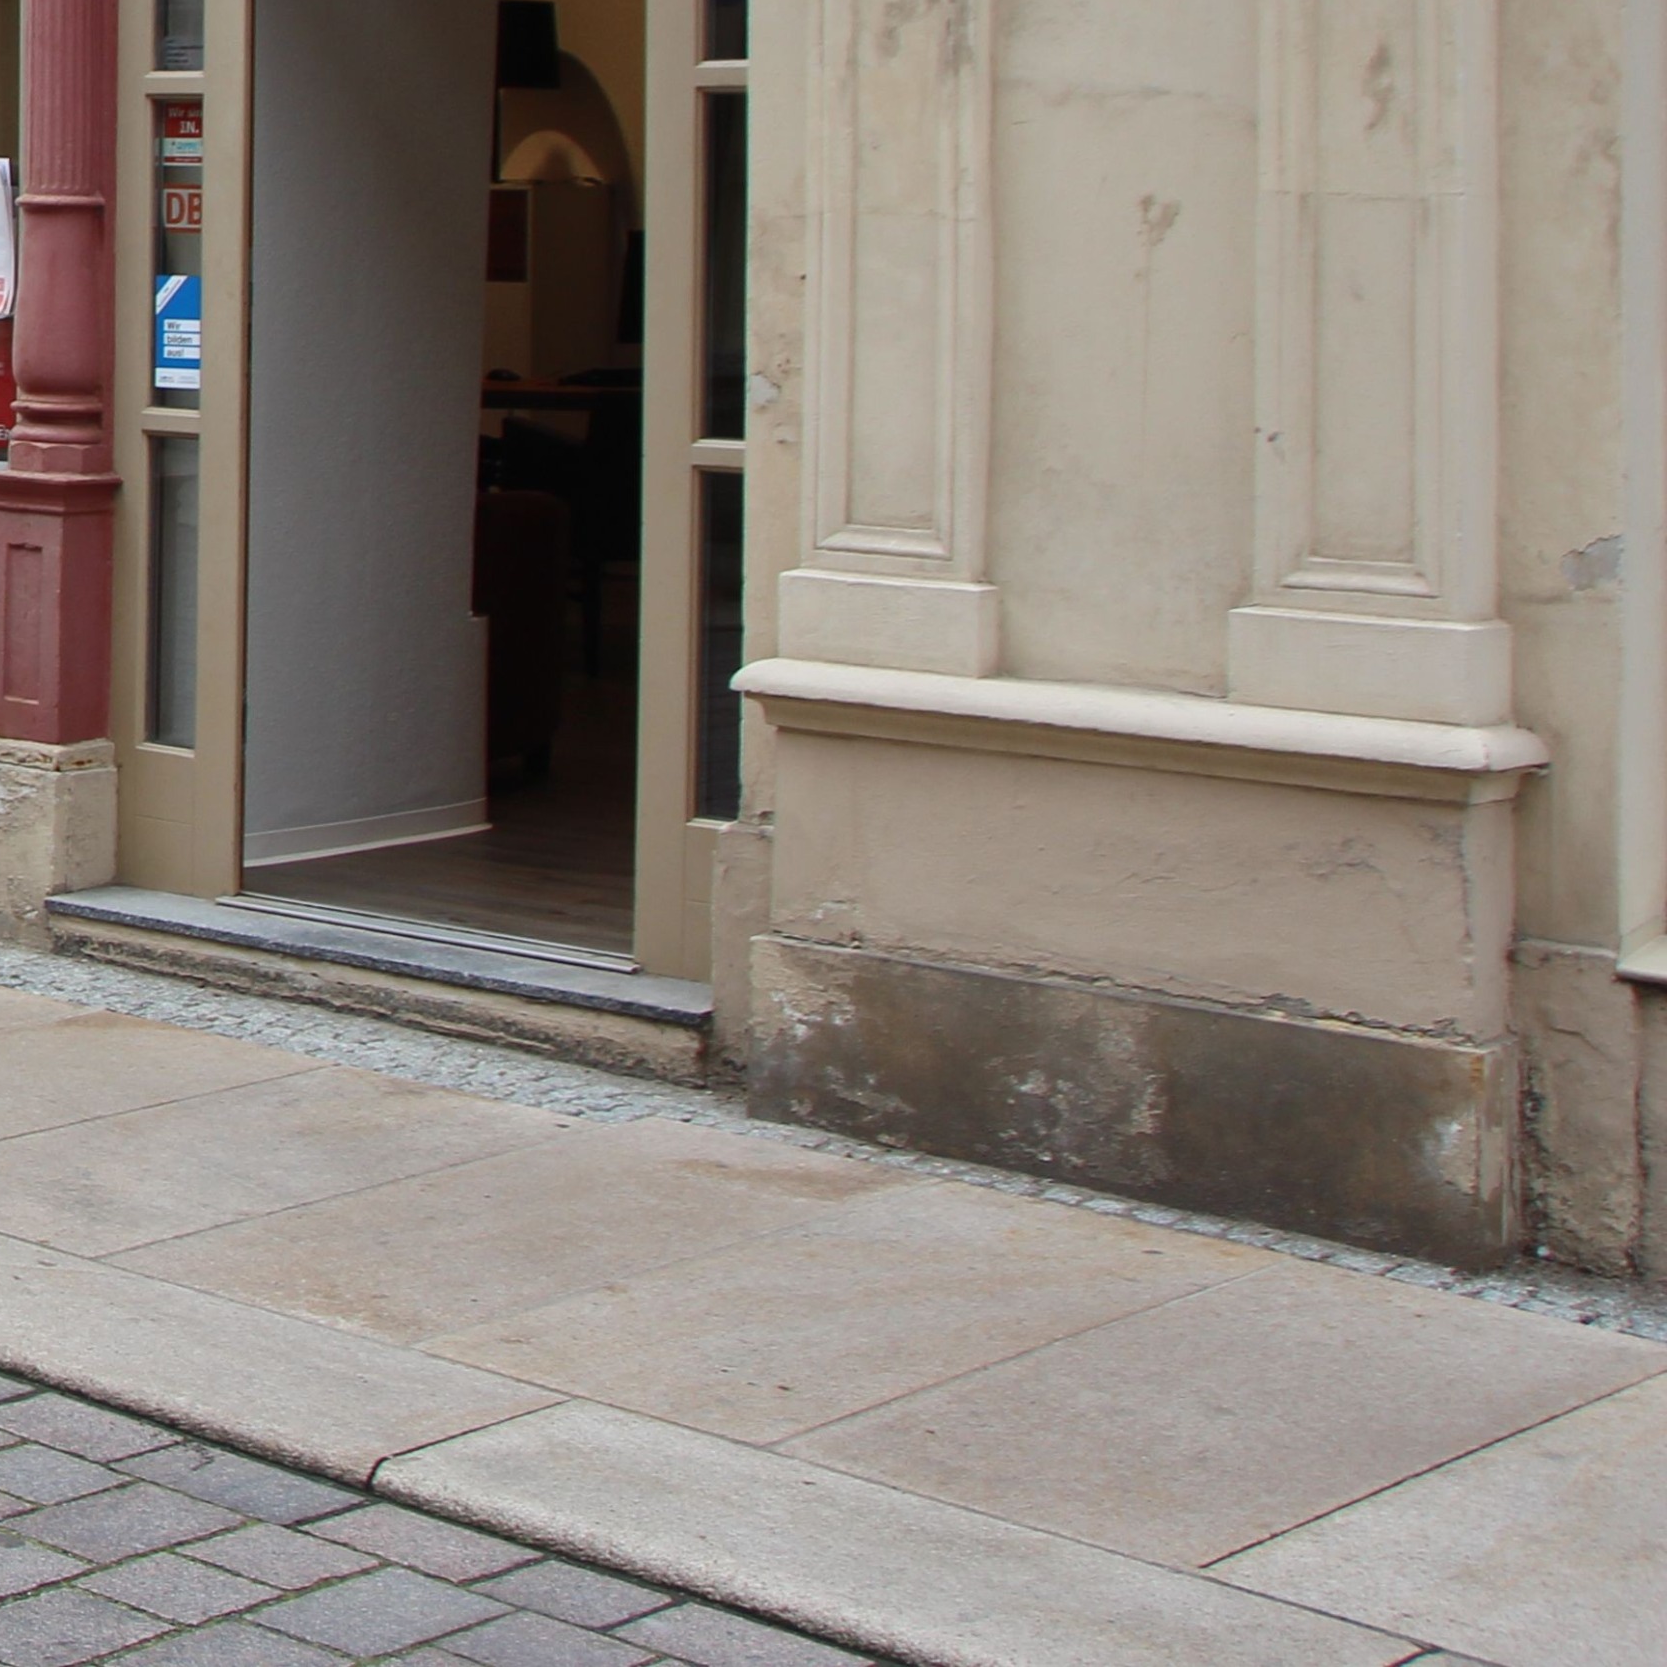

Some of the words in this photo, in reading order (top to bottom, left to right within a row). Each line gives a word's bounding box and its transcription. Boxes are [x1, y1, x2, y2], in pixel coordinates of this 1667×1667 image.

[166, 192, 202, 225] DB
[167, 321, 181, 330] Wir
[167, 335, 193, 344] bilden
